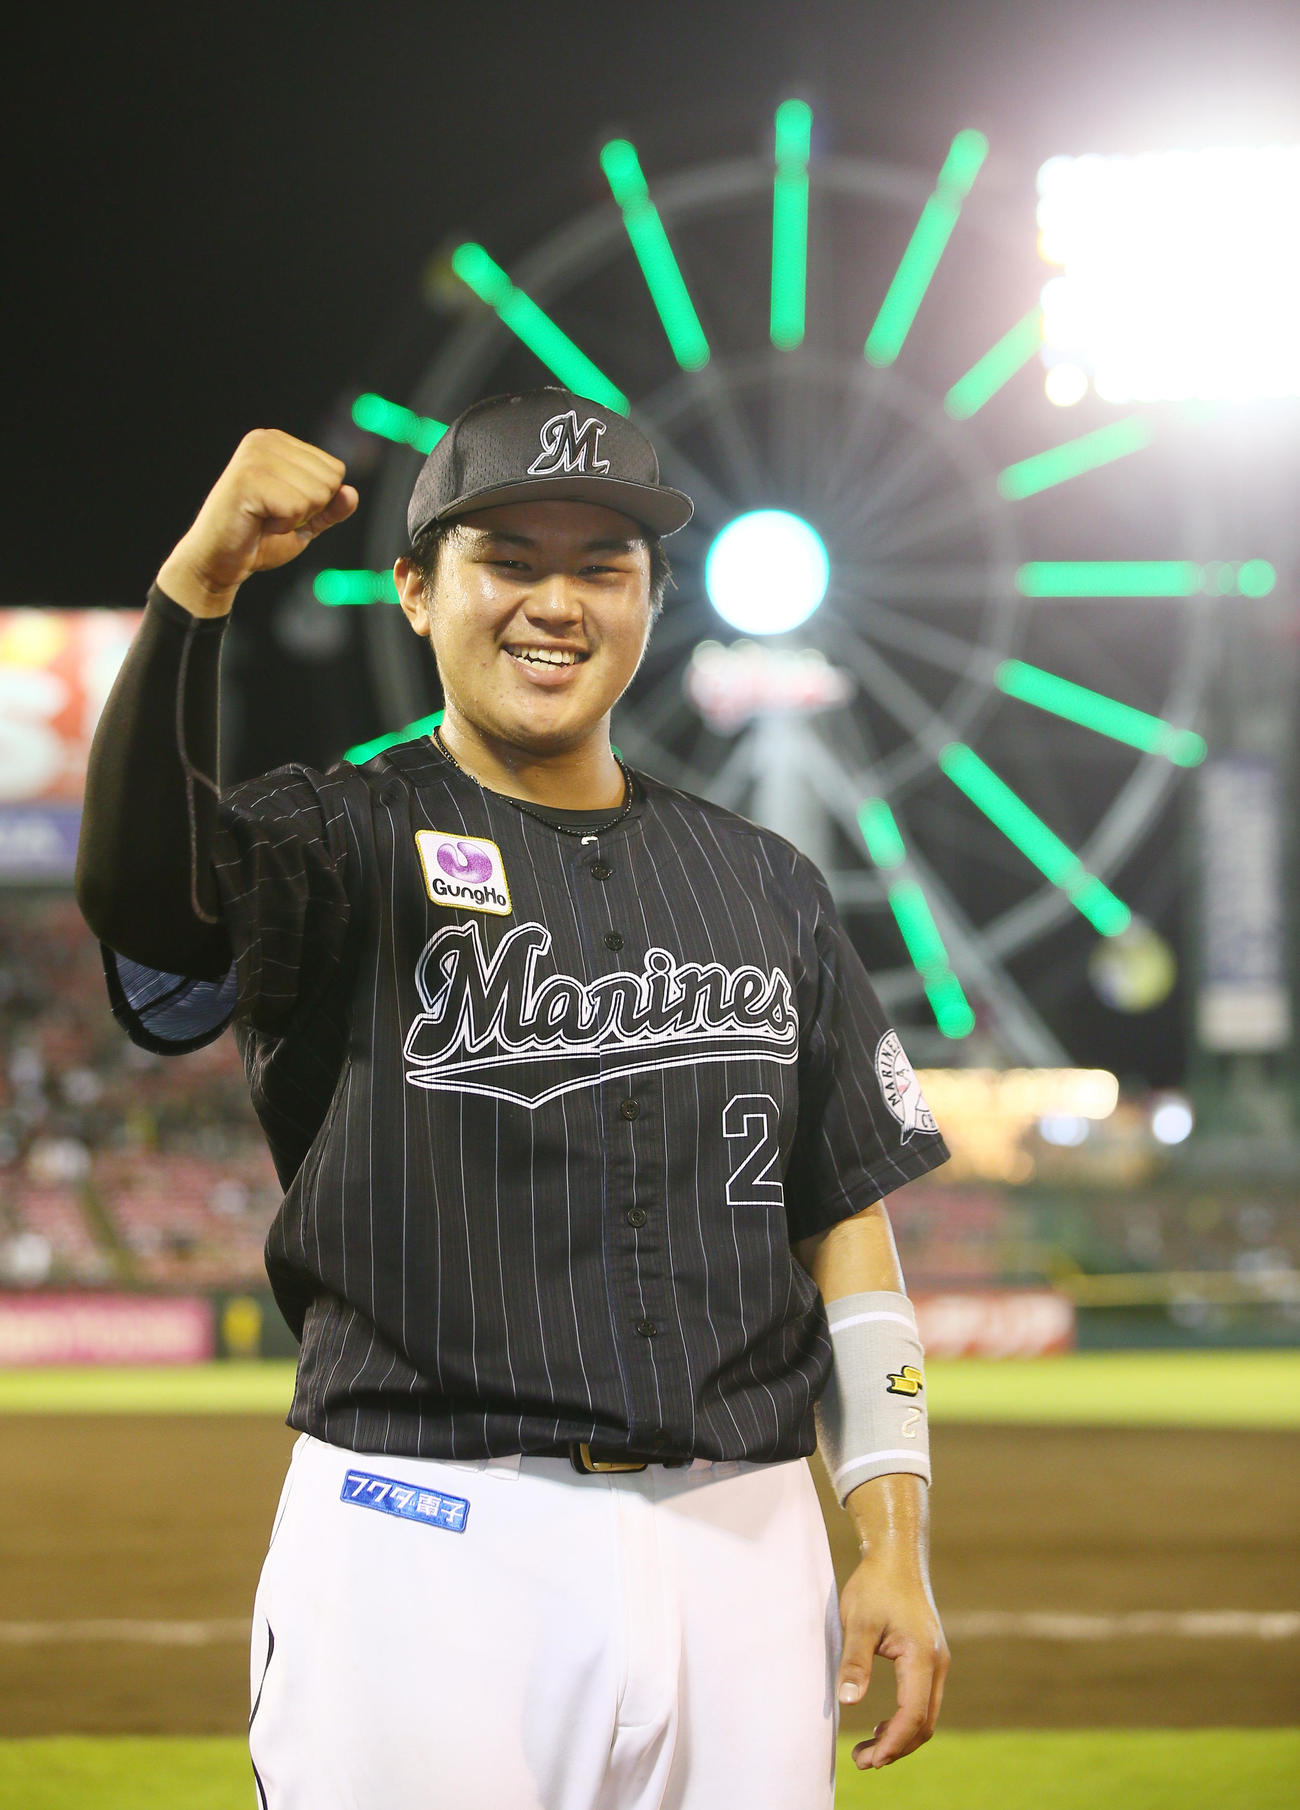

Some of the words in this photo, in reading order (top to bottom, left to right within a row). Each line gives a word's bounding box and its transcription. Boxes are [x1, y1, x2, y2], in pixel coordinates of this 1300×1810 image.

[527, 409, 610, 475] M
[432, 878, 506, 906] GungHo
[404, 920, 799, 1065] Marines
[723, 1093, 784, 1207] 2
[347, 1475, 466, 1523] フクダ電子
